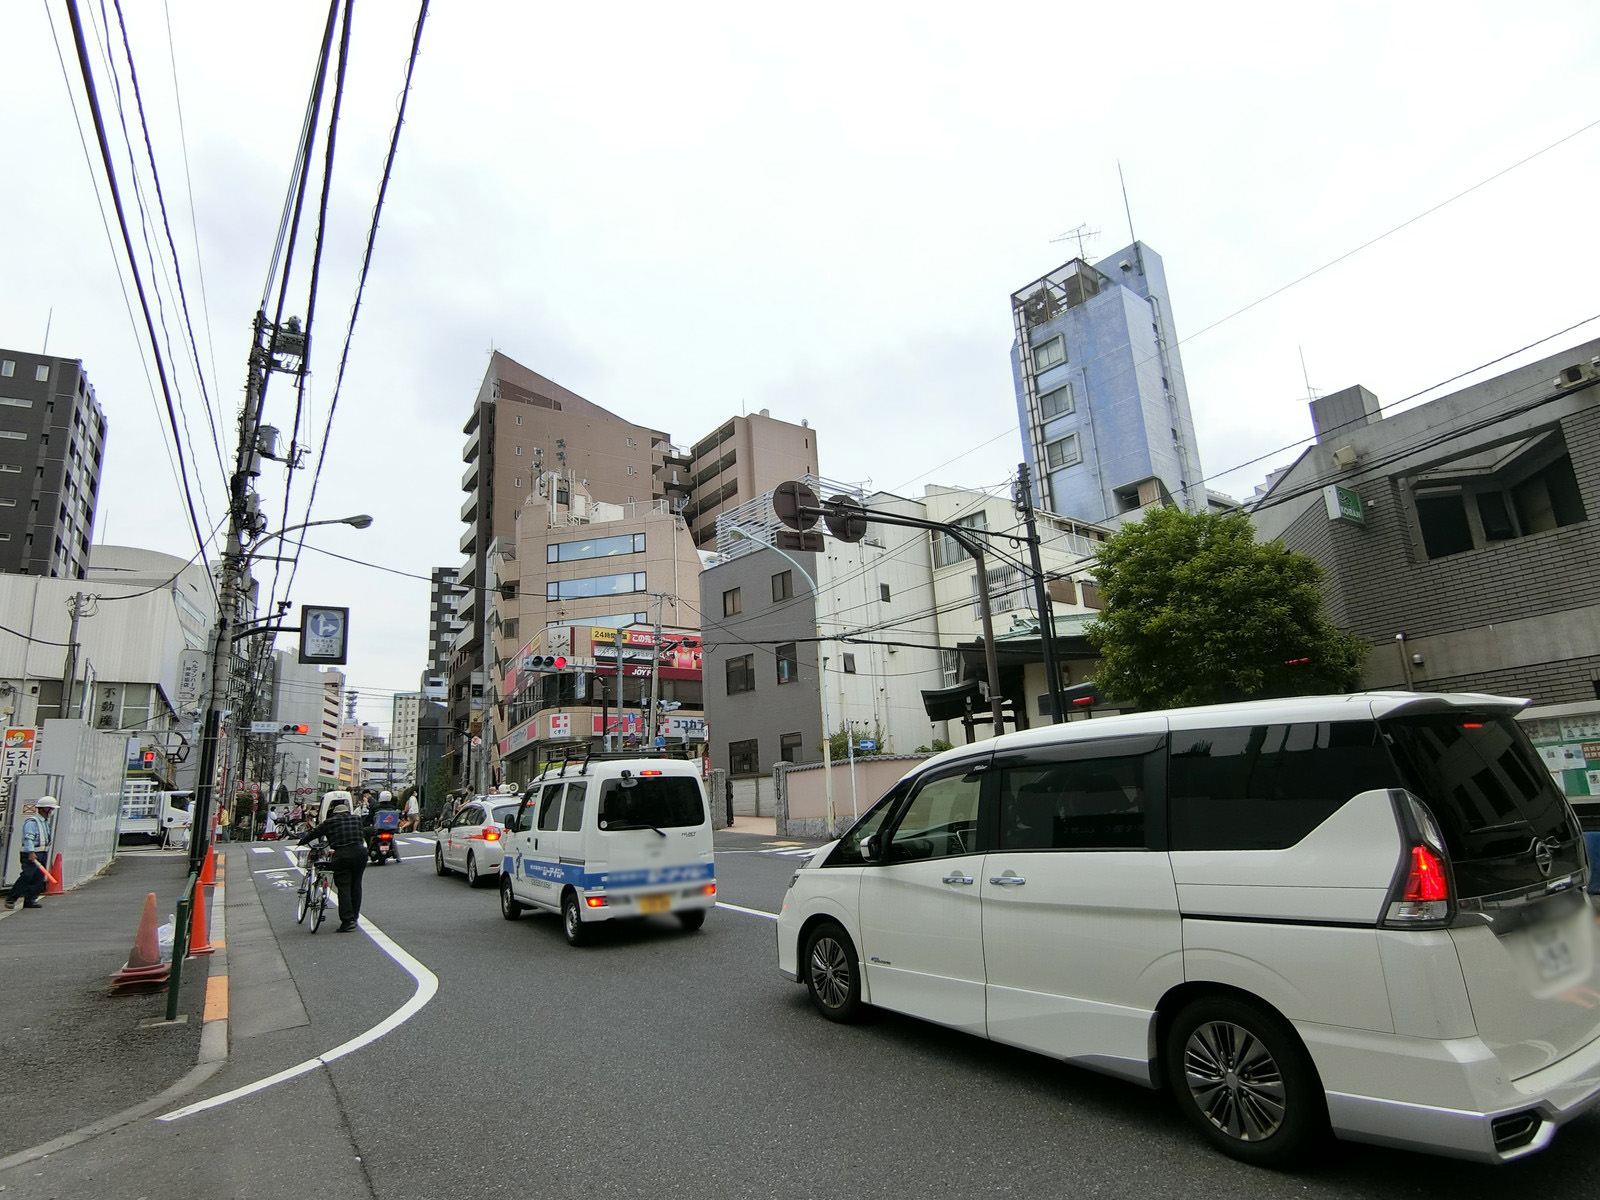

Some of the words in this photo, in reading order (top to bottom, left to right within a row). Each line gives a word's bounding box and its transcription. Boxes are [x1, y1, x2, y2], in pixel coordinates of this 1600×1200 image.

[1341, 506, 1362, 519] KOBAN
[100, 687, 117, 727] 不動産
[673, 719, 704, 729] ココカラ
